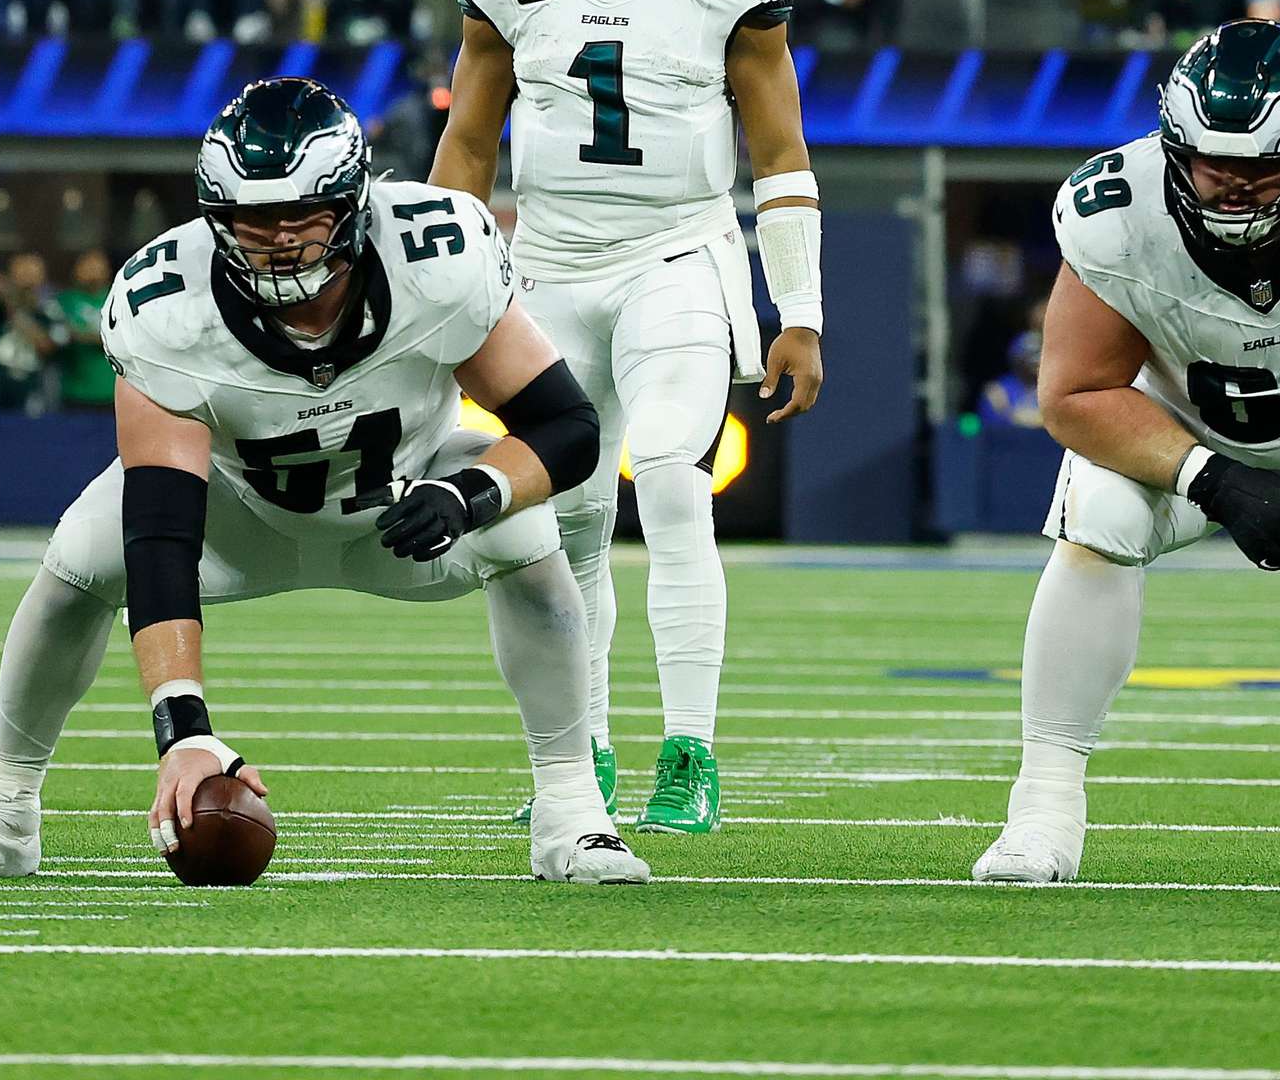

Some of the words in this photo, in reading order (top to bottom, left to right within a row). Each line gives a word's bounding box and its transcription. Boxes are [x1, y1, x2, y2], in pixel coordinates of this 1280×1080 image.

[581, 14, 630, 26] EAGLES
[567, 40, 643, 166] 1
[1068, 151, 1133, 218] 69
[392, 196, 465, 264] 51
[123, 239, 187, 317] 51
[297, 399, 353, 420] EAGLES
[235, 407, 404, 515] 51
